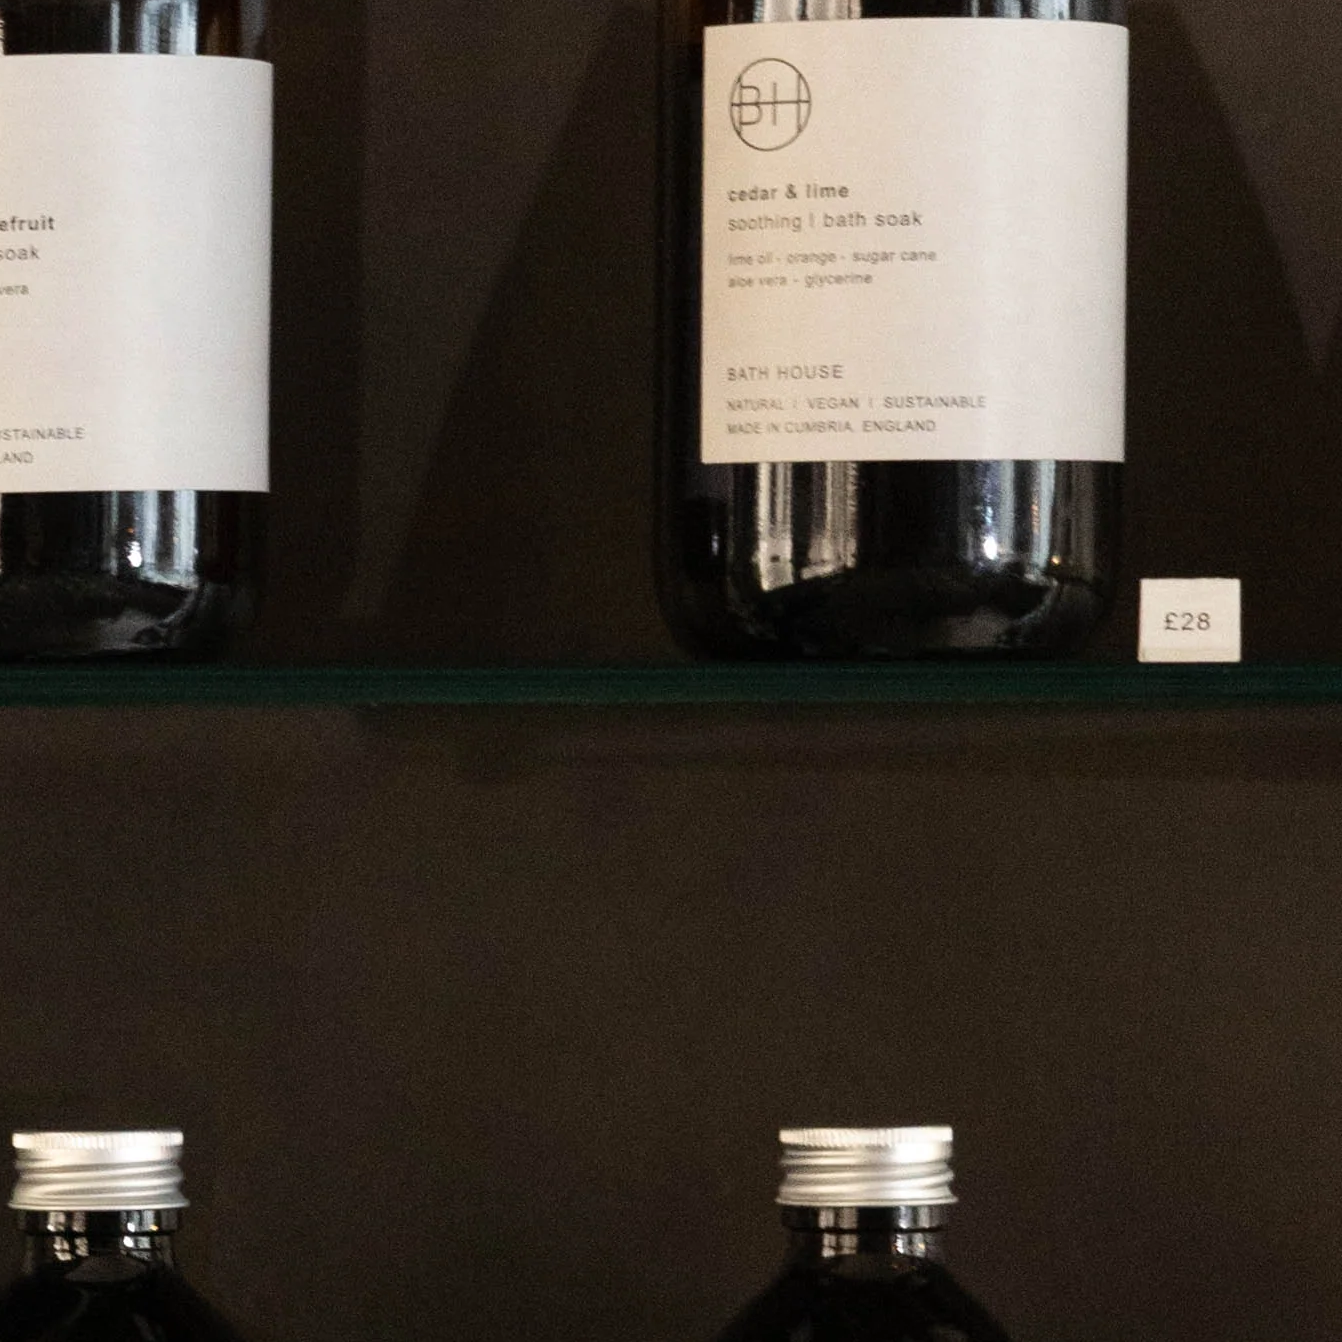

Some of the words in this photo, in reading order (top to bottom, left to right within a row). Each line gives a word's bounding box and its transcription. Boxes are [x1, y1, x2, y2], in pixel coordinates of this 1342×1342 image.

[727, 186, 777, 202] cedar
[785, 183, 798, 199] &
[806, 180, 850, 199] lime
[728, 214, 802, 232] soothing
[823, 211, 866, 228] bath
[874, 210, 923, 227] soak
[787, 251, 837, 267] orange
[852, 249, 896, 265] sugar
[901, 251, 937, 262] cane
[804, 272, 873, 288] glycerine
[727, 366, 769, 381] BATH
[777, 364, 844, 380] HOUSE
[727, 397, 784, 411] NATURAL
[806, 396, 859, 409] VEGAN
[884, 395, 987, 409] SUSTAINABLE
[727, 422, 761, 435] MADE
[768, 421, 780, 434] IN
[862, 419, 936, 433] ENGLAND
[1164, 611, 1211, 632] £28
